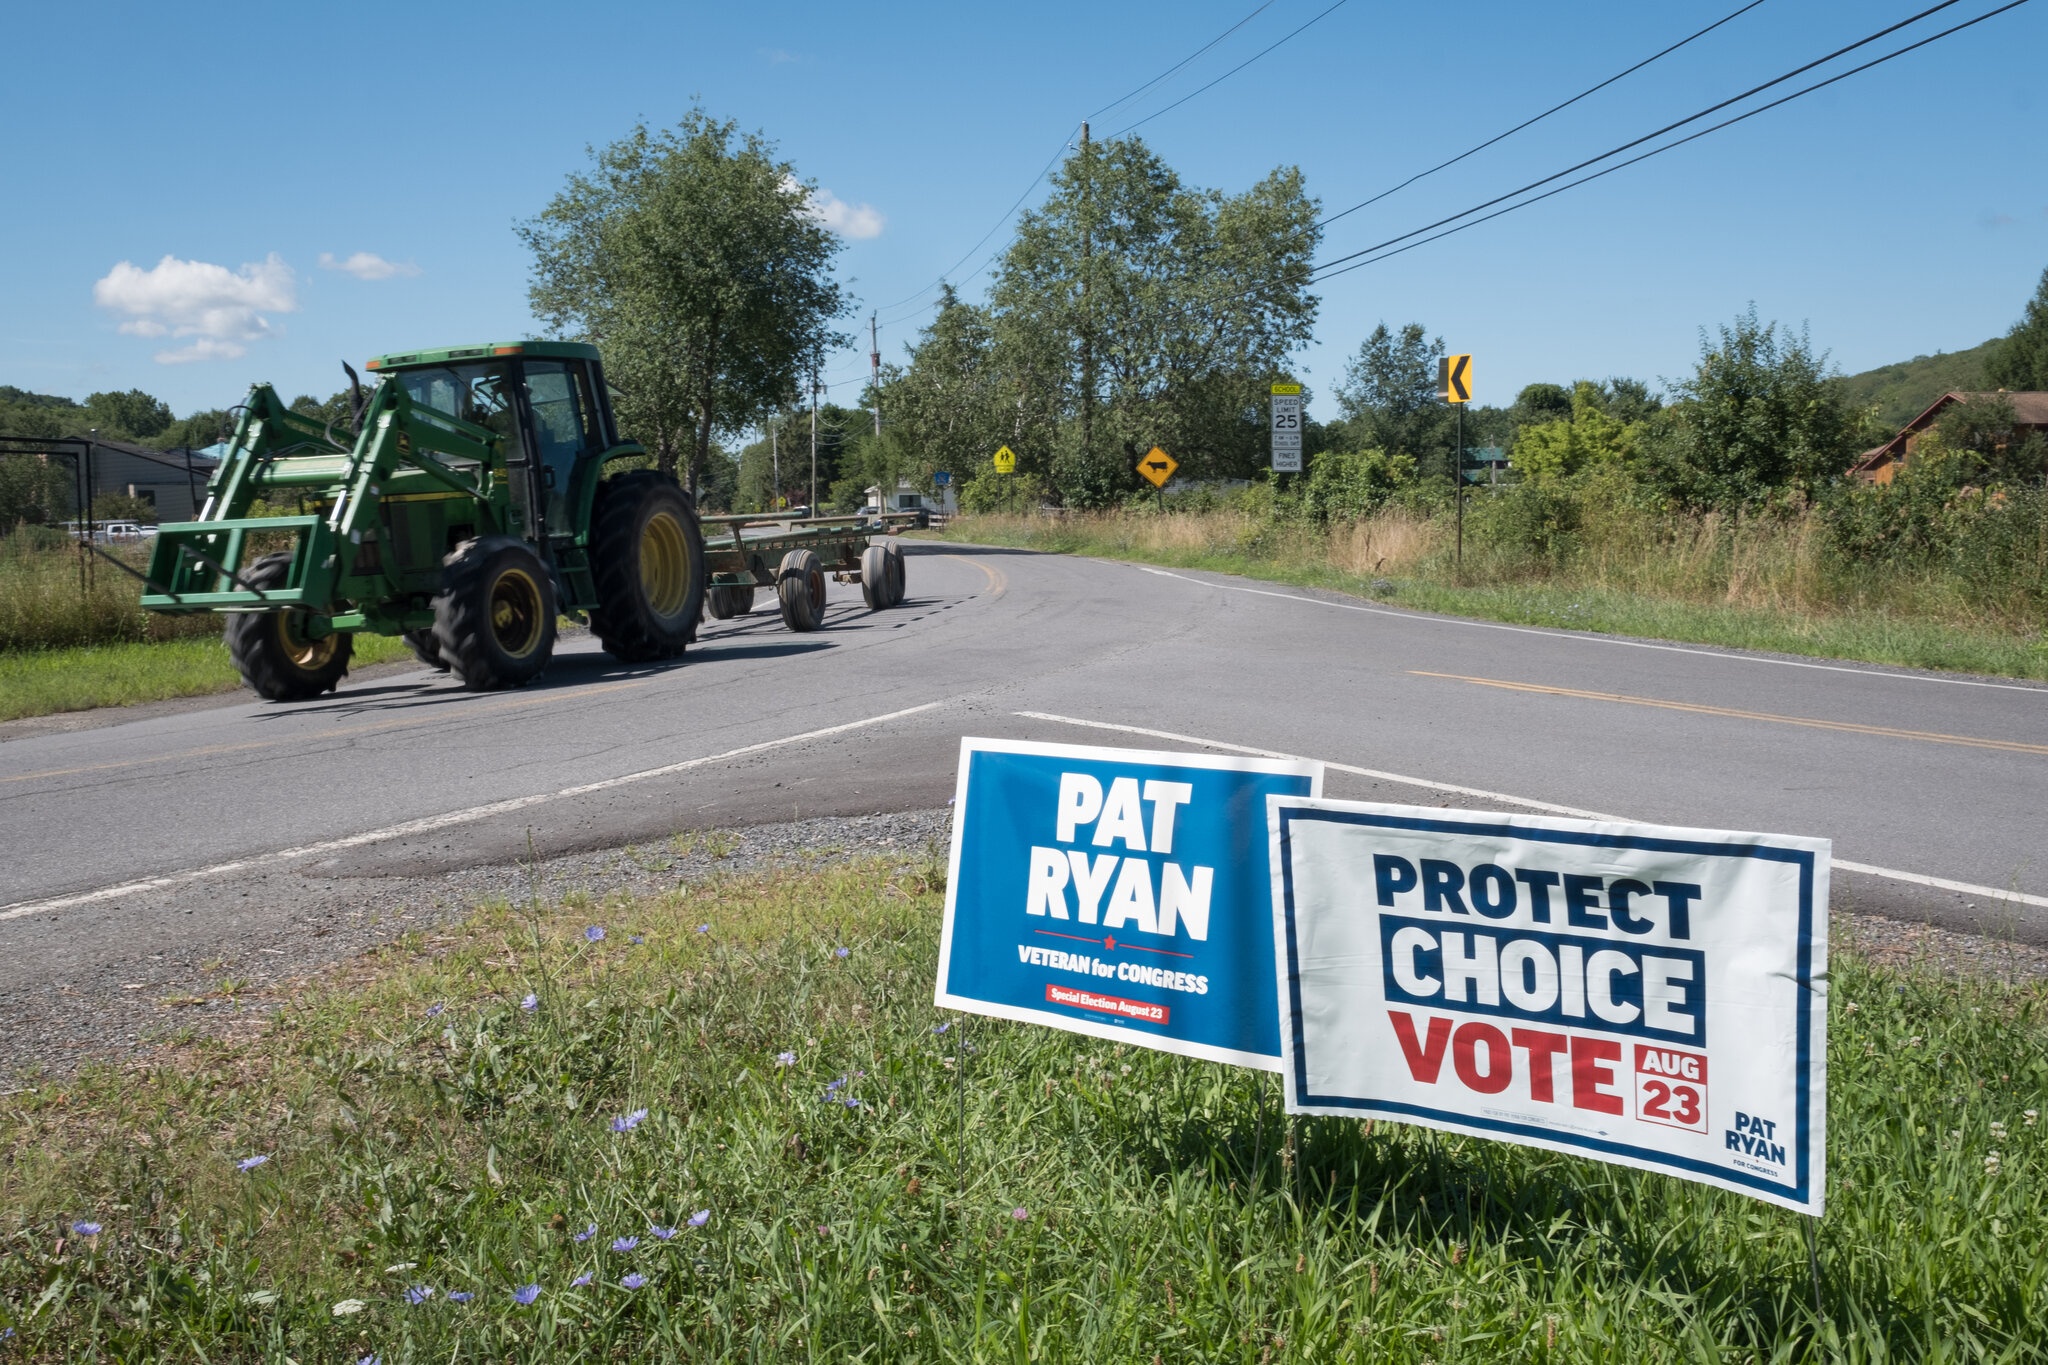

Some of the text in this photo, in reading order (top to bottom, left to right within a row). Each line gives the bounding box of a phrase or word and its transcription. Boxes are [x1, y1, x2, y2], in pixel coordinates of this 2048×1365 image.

[1275, 415, 1298, 428] 25
[1056, 772, 1193, 854] PAT
[1026, 845, 1214, 941] RYAN
[1373, 853, 1702, 940] PROTECT
[1018, 944, 1209, 995] VETERAN for CONGRESS
[1390, 926, 1695, 1035] CHOICE
[1051, 987, 1079, 1003] Special
[1080, 992, 1117, 1011] Election
[1117, 1000, 1150, 1017] August
[1150, 1006, 1163, 1019] 23
[1387, 1010, 1624, 1116] VOTE
[1642, 1049, 1700, 1080] AUG
[1642, 1080, 1701, 1126] 23
[1735, 1111, 1776, 1141] PAT
[1725, 1129, 1786, 1166] RYAN
[1733, 1159, 1778, 1177] FOR CONGRESS
